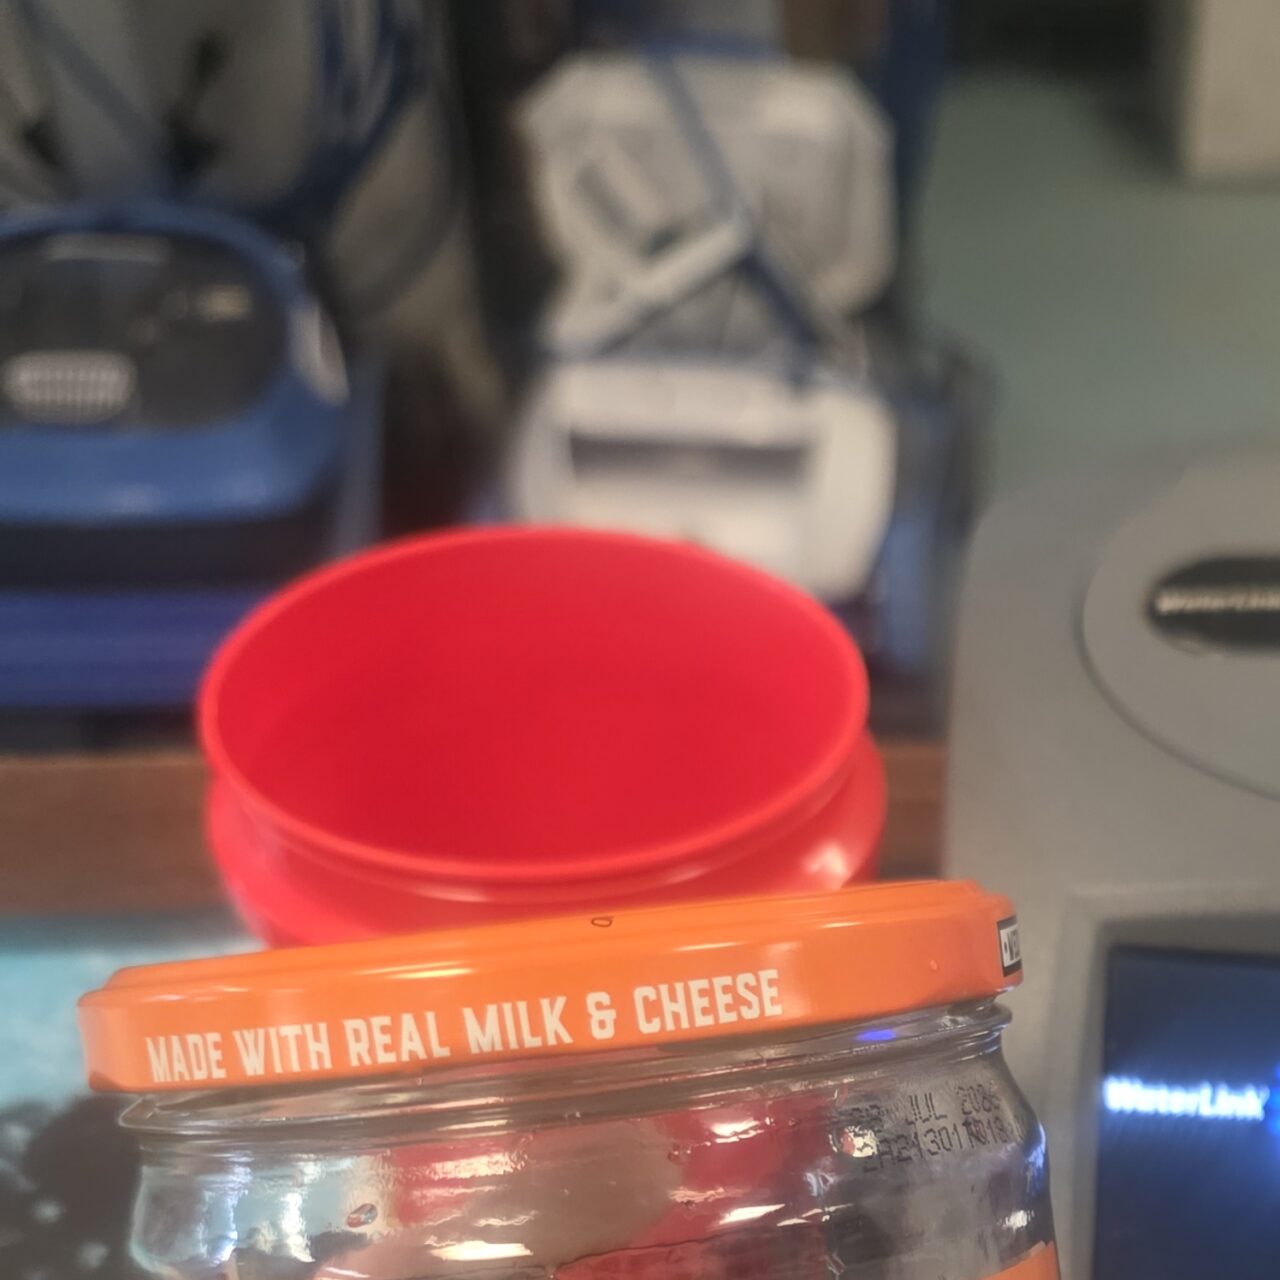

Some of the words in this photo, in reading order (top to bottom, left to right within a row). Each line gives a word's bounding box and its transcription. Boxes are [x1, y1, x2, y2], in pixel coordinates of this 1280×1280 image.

[146, 1032, 227, 1083] MADE
[233, 1022, 332, 1076] WITH
[343, 1011, 450, 1066] REAL
[462, 996, 573, 1054] MILK
[586, 991, 616, 1039] &
[633, 969, 783, 1034] CHEESE
